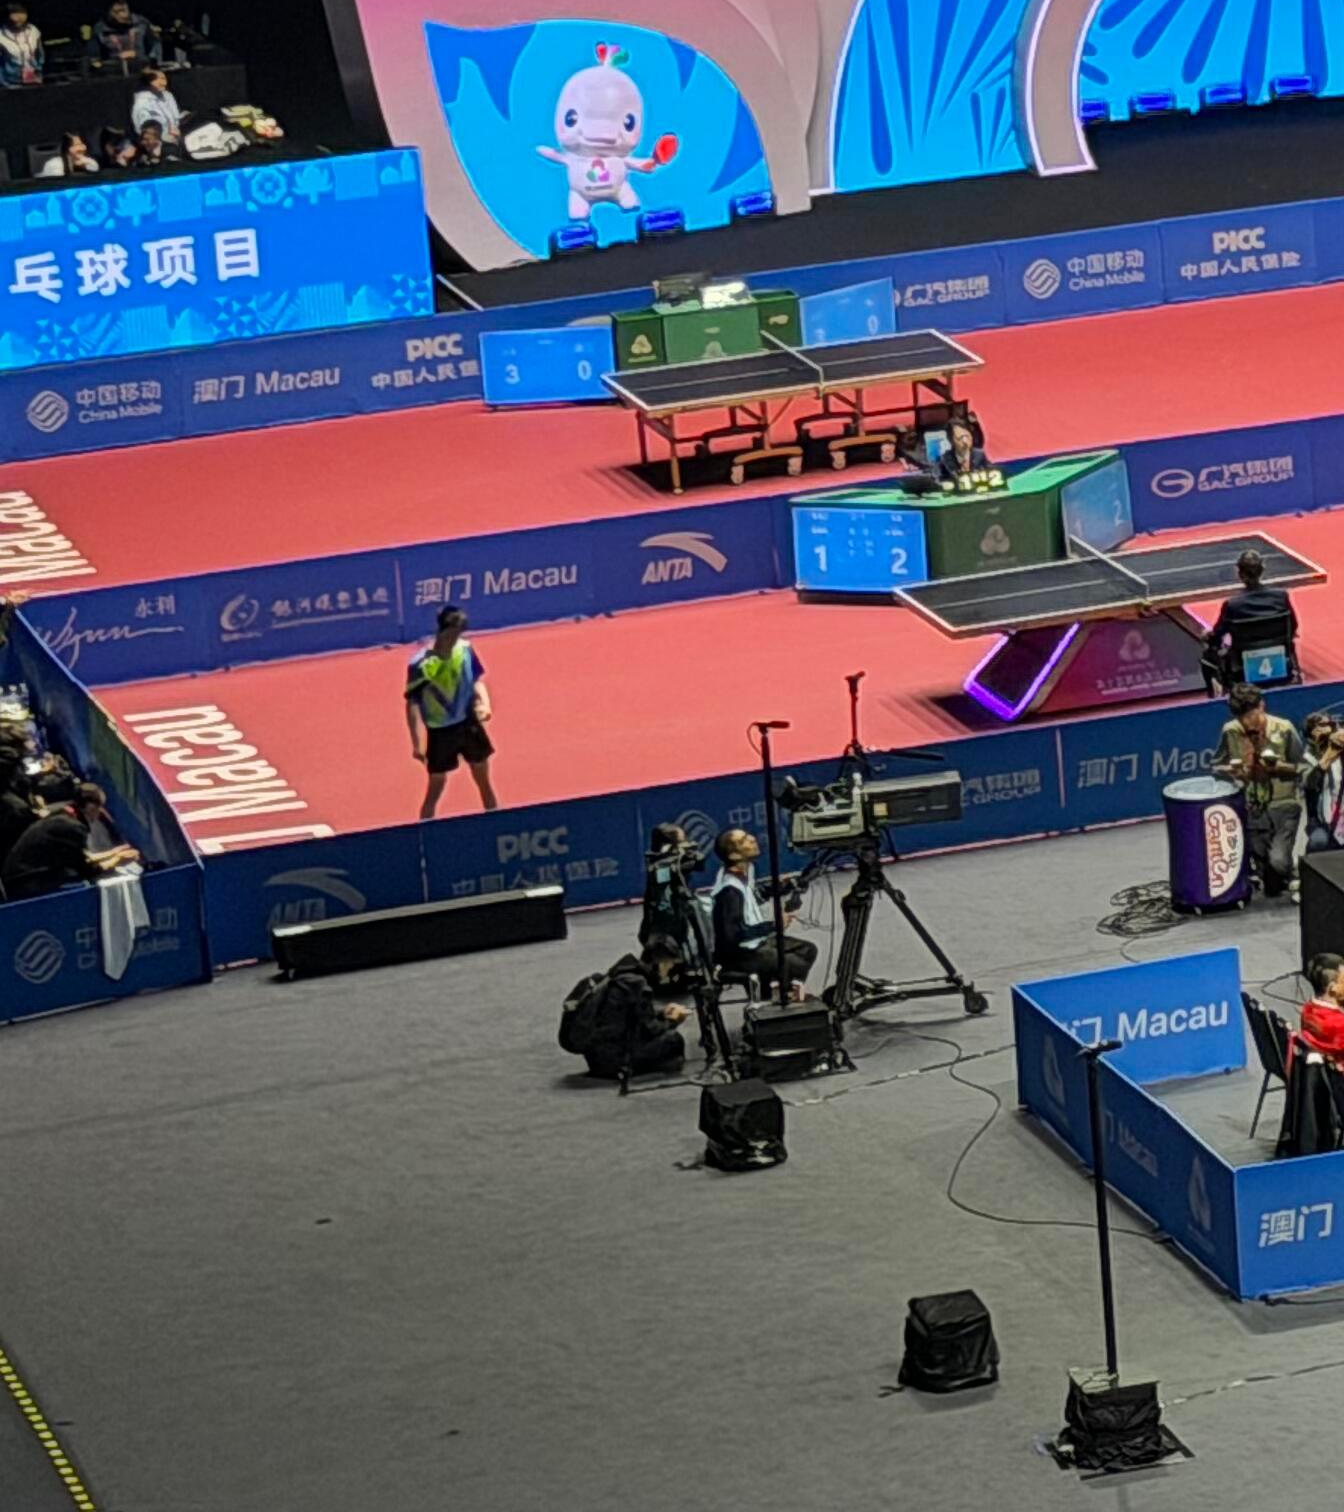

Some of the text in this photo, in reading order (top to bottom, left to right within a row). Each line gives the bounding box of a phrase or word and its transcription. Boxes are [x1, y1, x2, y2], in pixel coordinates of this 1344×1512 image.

[1211, 227, 1266, 254] PICC
[6, 228, 260, 303] 乓球项目
[1067, 249, 1146, 275] 中国移动
[1181, 250, 1301, 280] 中国人民保险
[405, 333, 464, 363] PICC
[255, 367, 341, 396] Macau
[504, 364, 521, 385] 3
[576, 358, 593, 380] 0
[75, 380, 162, 408] 中国移动
[641, 556, 693, 585] ANTA
[814, 545, 828, 572] 1
[890, 548, 908, 574] 2
[414, 573, 472, 606] 澳门
[483, 564, 578, 596] Macau
[123, 704, 309, 824] Macau
[1152, 746, 1215, 777] Mac
[497, 826, 569, 863] PICC
[1116, 1000, 1229, 1043] Macau
[1258, 1201, 1334, 1248] 澳门
